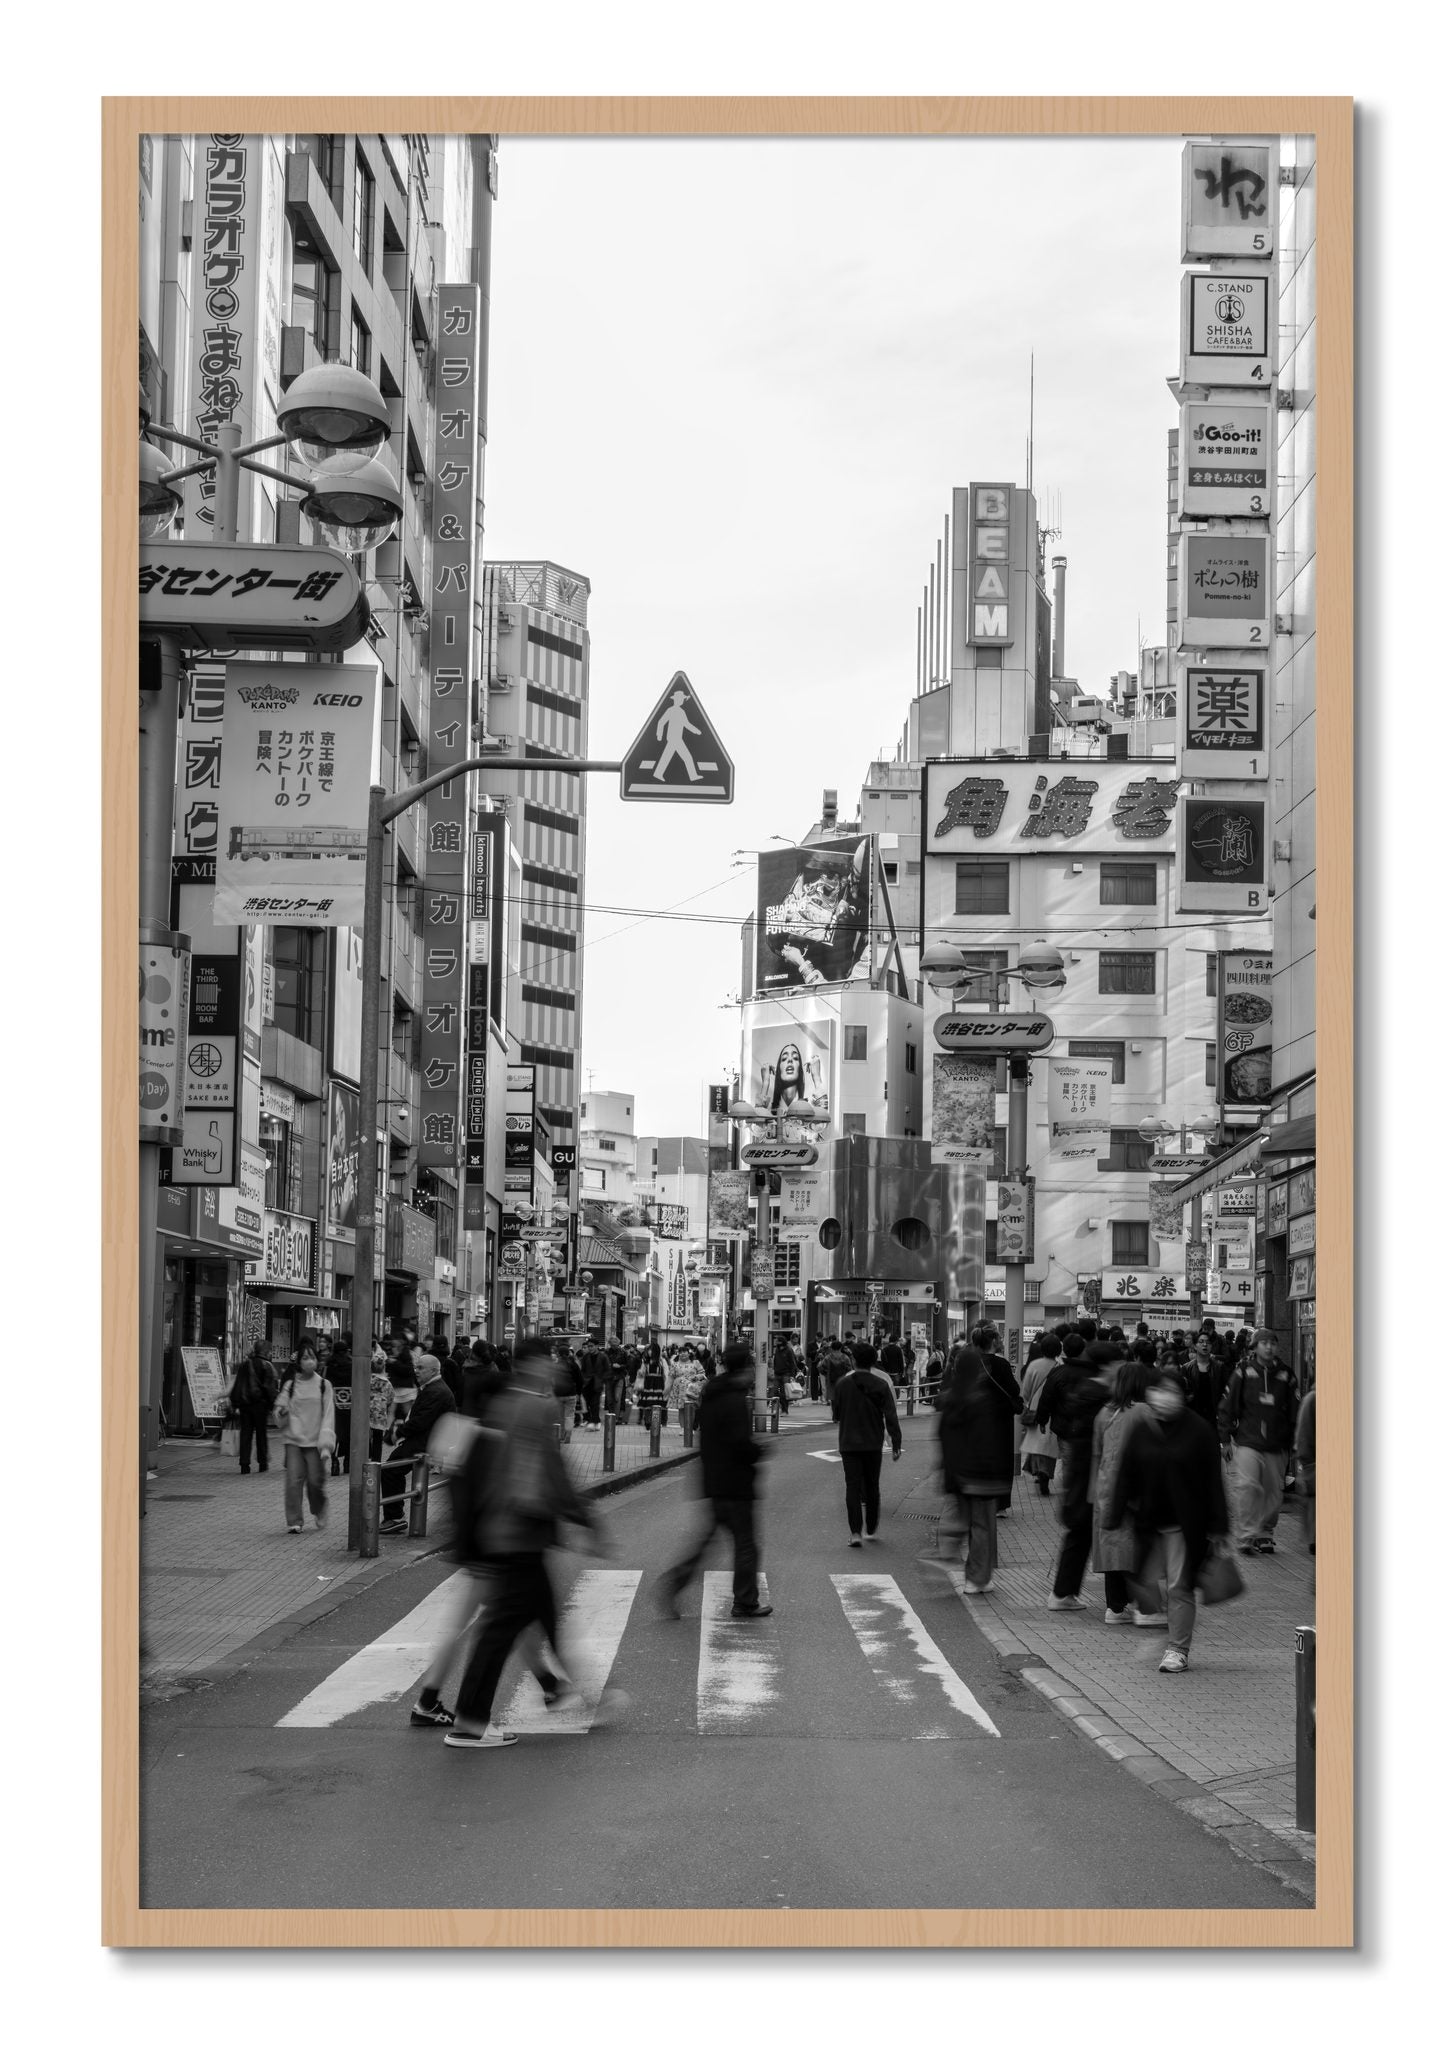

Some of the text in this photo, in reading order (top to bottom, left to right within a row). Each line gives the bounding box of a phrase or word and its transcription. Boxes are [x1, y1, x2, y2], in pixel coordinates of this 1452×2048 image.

[203, 146, 246, 290] カラオケ
[1253, 234, 1265, 250] 5
[1207, 283, 1253, 293] C.STAND
[1207, 325, 1253, 336] SHISHA
[1251, 365, 1263, 381] 4
[1205, 426, 1261, 442] Goo-it!
[1198, 446, 1258, 456] 渋谷宇田川町店
[1192, 471, 1263, 485] 全身もみほぐし
[1250, 495, 1263, 512] 3
[975, 488, 1009, 637] BEAM
[139, 564, 343, 601] 谷センター街
[1194, 568, 1260, 588] ポムの樹
[1204, 592, 1251, 600] Pomme-no-ki
[1250, 626, 1261, 642] 2
[251, 702, 287, 710] KANTO
[313, 694, 363, 707] KEIO
[1197, 676, 1249, 729] 薬
[1191, 731, 1255, 746] マツモトキヨシ
[256, 731, 273, 774] 冒険へ
[274, 731, 293, 807] カントーの
[295, 731, 314, 807] ポケパーク
[318, 731, 335, 793] 京王線で
[1249, 758, 1258, 775] 1
[934, 776, 1180, 838] 角海老
[1192, 816, 1254, 866] 一蘭
[476, 837, 486, 914] kimono hearts
[243, 898, 334, 912] 渋谷センター街
[1248, 890, 1260, 906] B
[196, 975, 218, 983] THIRD
[1227, 972, 1272, 985] 四川料理
[195, 1004, 218, 1012] ROOM
[199, 1015, 214, 1023] BAR
[941, 1022, 1047, 1036] 渋谷センター街
[1224, 1031, 1255, 1052] 6F
[147, 1082, 167, 1096] Day!
[188, 1094, 229, 1102] SAKE BAR
[184, 1148, 218, 1160] Whisky
[554, 1152, 574, 1163] GU
[745, 1149, 809, 1158] 渋谷センター街
[183, 1158, 204, 1167] Bank
[1152, 1159, 1211, 1167] 渋谷センター街
[1116, 1275, 1177, 1297] 兆楽
[676, 1273, 685, 1317] BEER
